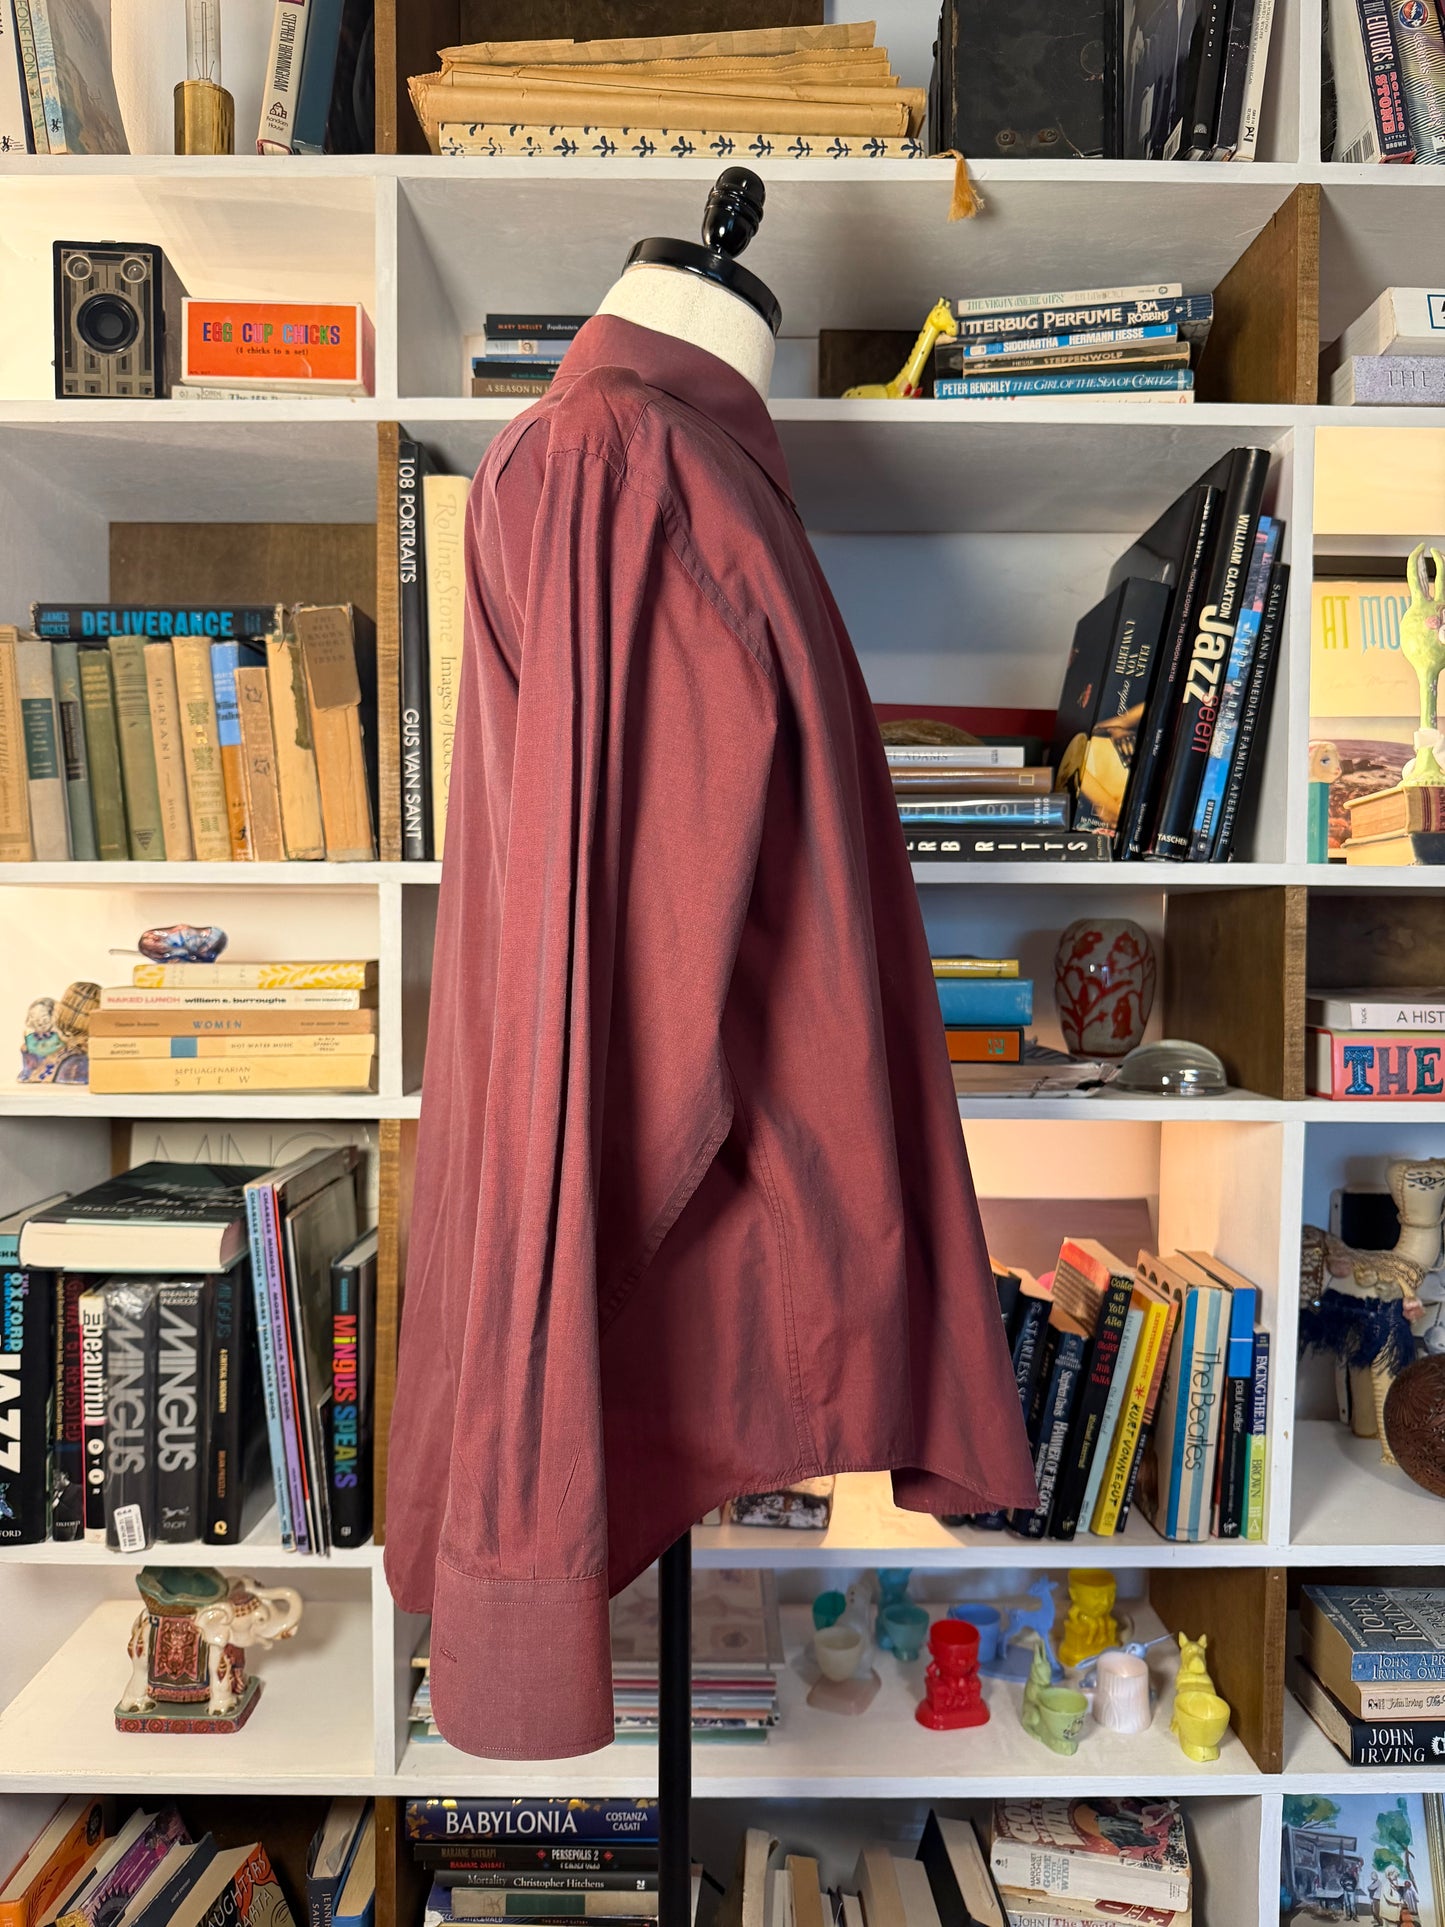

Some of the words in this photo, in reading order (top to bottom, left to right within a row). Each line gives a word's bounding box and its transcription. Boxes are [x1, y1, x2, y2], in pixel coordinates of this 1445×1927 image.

[280, 12, 297, 44] STEPHEN
[1366, 15, 1394, 63] EDITORS
[274, 44, 294, 92] BIRMINGHAM
[1375, 74, 1396, 135] STONE
[1390, 72, 1405, 132] ROLLING
[266, 115, 288, 127] Random
[268, 122, 284, 132] House
[1385, 141, 1407, 150] BROWN
[1127, 310, 1169, 325] ROBBINS
[1135, 300, 1159, 313] TOM
[202, 322, 232, 342] EGG
[242, 323, 273, 343] CUP
[283, 323, 341, 345] CHICKS
[960, 314, 1039, 336] ITTERBUG
[1043, 307, 1122, 330] PERFUME
[247, 347, 270, 355] chicks
[1003, 337, 1058, 353] SIDDHARTHA
[1069, 331, 1114, 345] HERMANN
[1115, 327, 1145, 341] HESSE
[1044, 352, 1123, 365] STEPPENWOLF
[487, 384, 493, 393] A
[494, 384, 530, 394] SEASON
[532, 385, 542, 393] IN
[942, 382, 968, 396] PETER
[970, 380, 1011, 394] BENCHLEY
[1384, 370, 1430, 388] THE
[399, 458, 416, 489] 108
[400, 494, 417, 584] PORTRAITS
[1230, 514, 1251, 565] WILLIAM
[1189, 569, 1197, 594] MICHAEL
[1219, 567, 1240, 619] CLAXTON
[1266, 583, 1281, 620] SALLY
[41, 612, 70, 623] JAMES
[41, 624, 70, 636] DICKEY
[81, 611, 234, 636] DELIVERANCE
[1321, 595, 1350, 650] AT
[1114, 619, 1136, 675] UNWERTH
[1174, 635, 1184, 663] LONDON
[1182, 604, 1235, 706] Jazz
[1258, 624, 1273, 660] MANN
[1125, 652, 1140, 676] VON
[1134, 643, 1151, 678] ELLEN
[1168, 663, 1177, 683] SIXTIES
[1243, 664, 1265, 732] IMMEDIATE
[154, 677, 171, 761] HERNANI
[403, 708, 420, 747] GUS
[1191, 692, 1218, 753] seen
[404, 751, 421, 789] VAN
[904, 753, 949, 762] ADAMS
[1233, 734, 1251, 780] FAMILY
[405, 794, 422, 841] SANT
[933, 806, 964, 816] THE
[974, 804, 1021, 816] COOL
[1033, 798, 1041, 824] VIKING
[1042, 797, 1050, 825] STUDIO
[1200, 800, 1214, 839] UNIVERSE
[1220, 782, 1240, 846] APERTURE
[975, 841, 1088, 851] RITTS
[1157, 833, 1188, 847] TASCHEN
[107, 996, 142, 1004] NAKED
[144, 996, 181, 1004] LUNCH
[232, 996, 287, 1006] burroughs
[193, 1021, 243, 1029] WOMEN
[1396, 1010, 1408, 1024] A
[1343, 1045, 1444, 1096] THE
[249, 1191, 259, 1234] CHARLES
[262, 1191, 272, 1234] CHARLES
[254, 1237, 262, 1278] MINGUS
[267, 1238, 276, 1278] MINGUS
[22, 1273, 30, 1296] THE
[4, 1272, 12, 1335] COMPANION
[10, 1272, 24, 1352] OXFORD
[258, 1291, 267, 1320] MORE
[272, 1291, 280, 1321] MORE
[4, 1339, 12, 1352] TO
[261, 1322, 270, 1350] THAN
[275, 1324, 283, 1350] THAN
[83, 1325, 106, 1418] beautiful
[265, 1363, 274, 1389] FAKE
[279, 1363, 287, 1389] FAKE
[1192, 1347, 1222, 1389] The
[107, 1306, 146, 1474] MINGUS
[157, 1305, 198, 1472] MINGUS
[1055, 1369, 1071, 1397] Stephen
[1233, 1379, 1244, 1405] paul
[268, 1391, 276, 1420] BOOK
[282, 1391, 290, 1420] BOOK
[1052, 1396, 1066, 1418] Davis
[1128, 1401, 1142, 1438] KURT
[1231, 1404, 1243, 1434] weller
[1253, 1393, 1266, 1418] THE
[1046, 1420, 1068, 1461] HAMMER
[1184, 1391, 1216, 1471] Beatles
[1252, 1418, 1265, 1449] MUSIC
[1044, 1460, 1058, 1475] OF
[1110, 1439, 1133, 1507] VONNEGUT
[1250, 1458, 1263, 1499] BROWN
[1040, 1474, 1055, 1491] THE
[1372, 1665, 1412, 1680] IRVING
[1379, 1654, 1409, 1669] JOHN
[1419, 1655, 1428, 1667] A
[1404, 1699, 1424, 1711] Irving
[1368, 1728, 1414, 1747] JOHN
[1360, 1747, 1426, 1764] IRVING
[445, 1810, 578, 1835] BABYLONIA
[605, 1812, 649, 1822] COSTANZA
[612, 1822, 641, 1831] CASATI
[441, 1848, 470, 1858] MARJANE
[471, 1848, 497, 1858] SATRAPI
[551, 1849, 590, 1861] PERSEPOLIS
[591, 1849, 599, 1861] 2
[467, 1873, 507, 1887] Mortality
[513, 1876, 566, 1889] Christopher
[566, 1877, 605, 1888] Hitchens
[1043, 1854, 1052, 1889] GONE
[1061, 1858, 1070, 1891] WIND
[1016, 1915, 1045, 1927] JOHN
